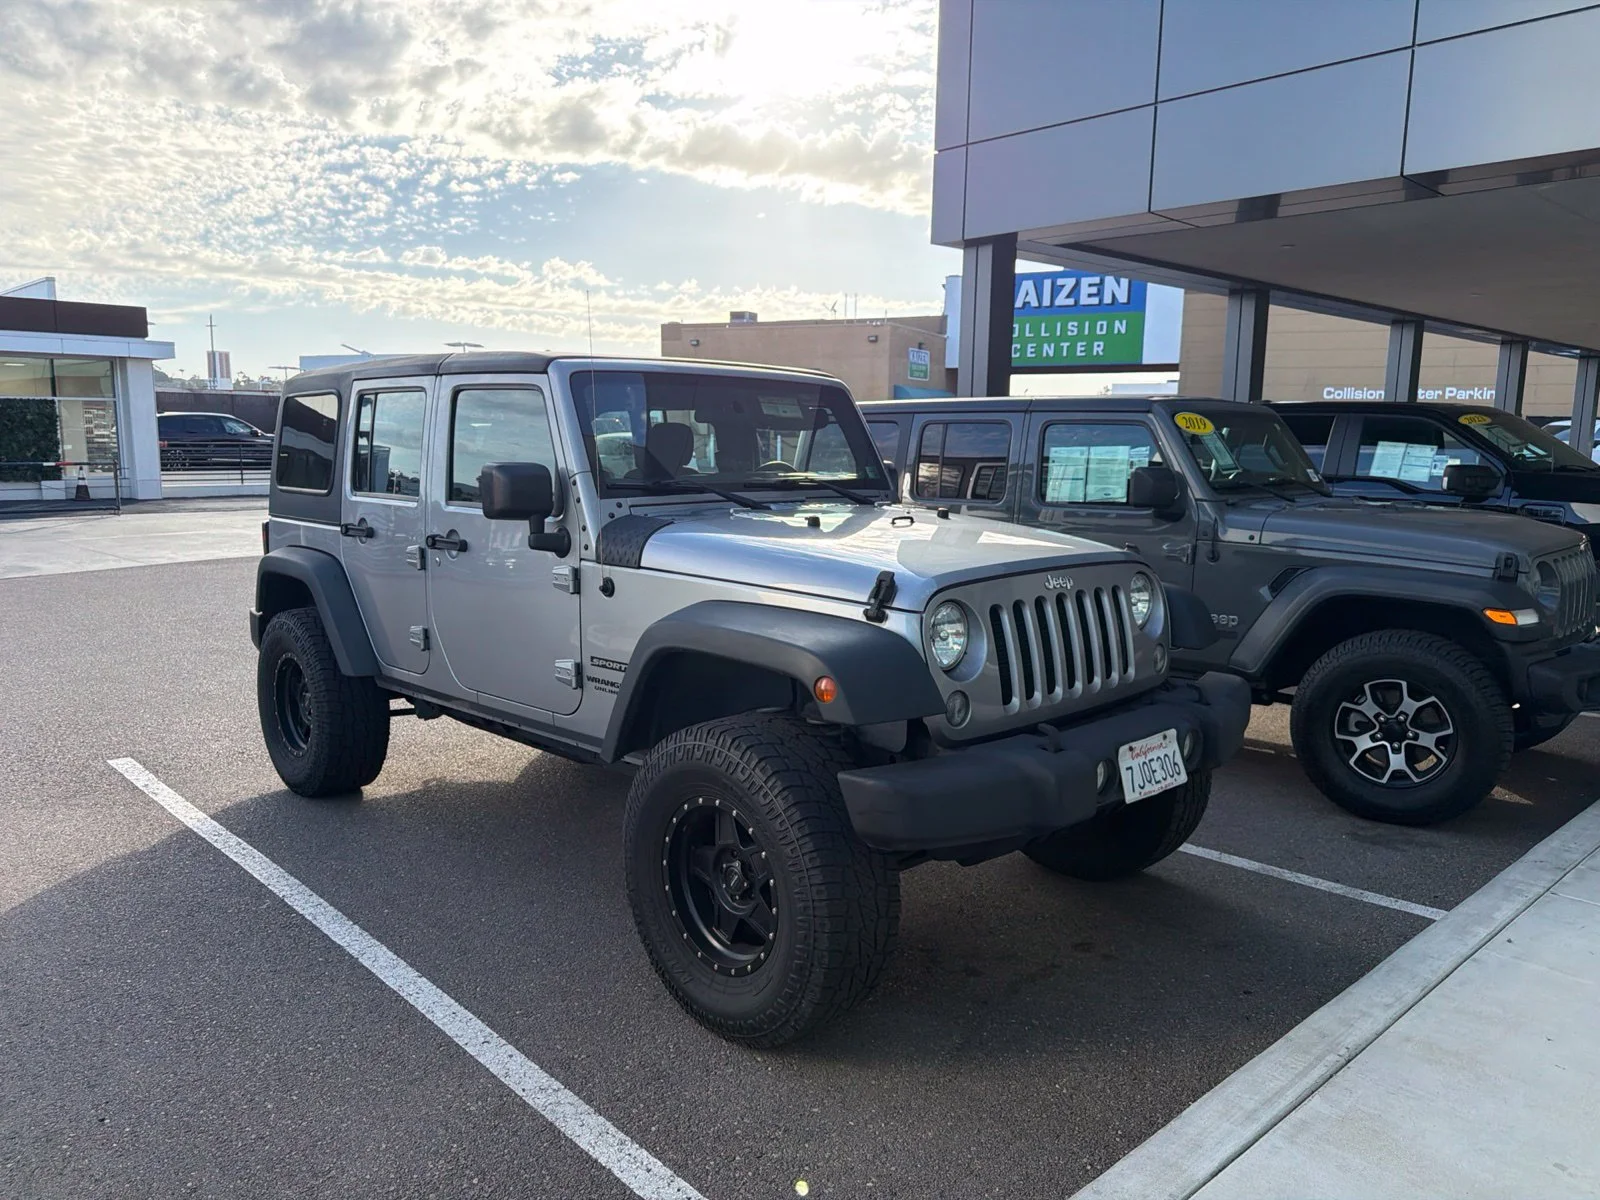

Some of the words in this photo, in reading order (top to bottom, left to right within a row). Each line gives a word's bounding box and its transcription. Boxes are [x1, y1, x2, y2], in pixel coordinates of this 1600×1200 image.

[1014, 275, 1129, 309] AIZEN
[1012, 319, 1127, 337] OLLISION
[1011, 341, 1105, 358] CENTER
[1323, 387, 1385, 400] Collision
[1417, 387, 1443, 400] ter
[1444, 386, 1496, 400] Parkin
[1182, 416, 1207, 430] 2019
[1044, 574, 1074, 590] Jeep
[1210, 613, 1239, 628] eep
[592, 658, 628, 671] SPORT
[586, 675, 621, 689] WRANG
[1125, 750, 1181, 793] 7JQE306
